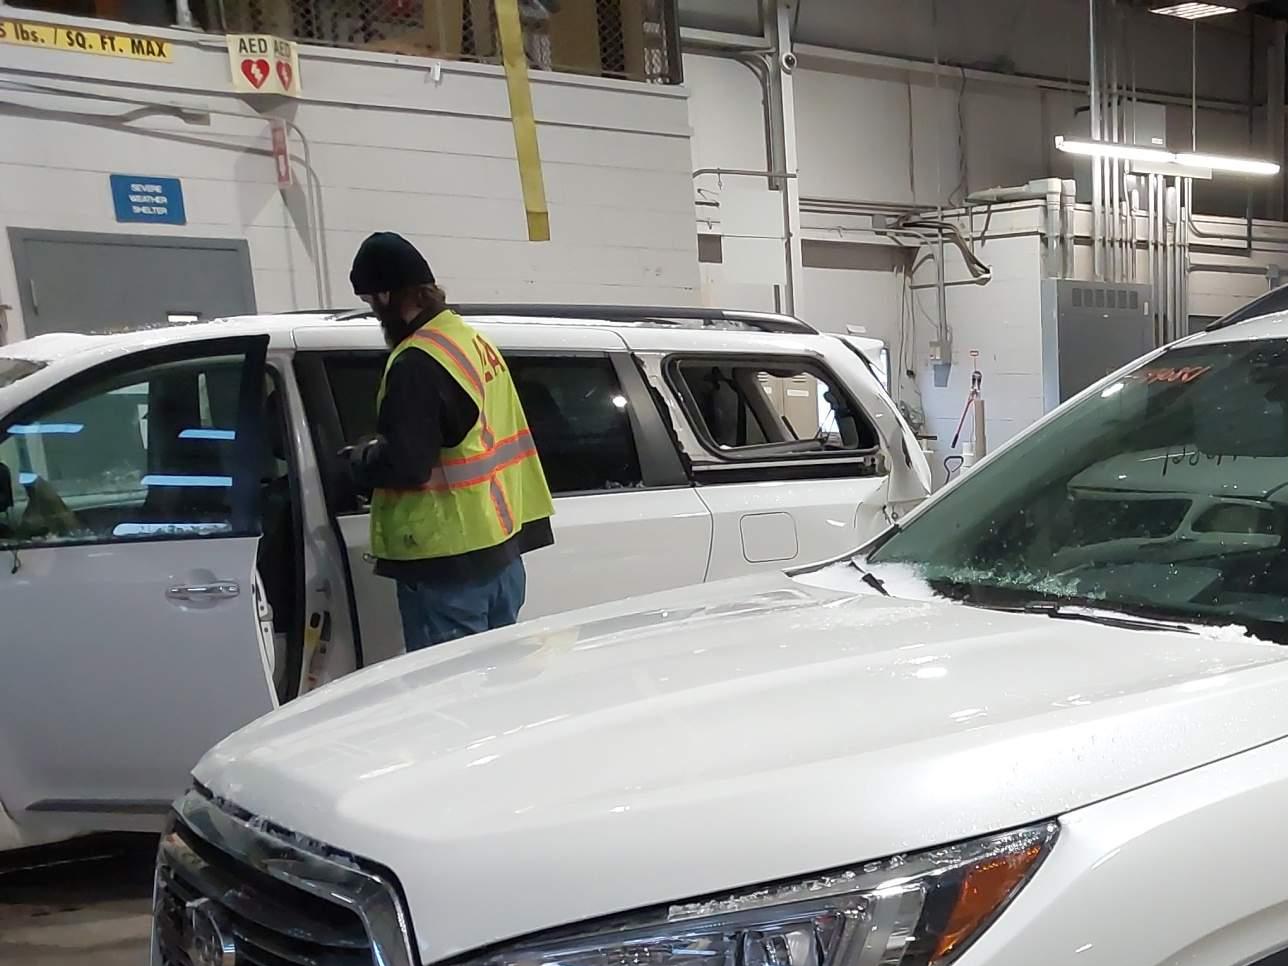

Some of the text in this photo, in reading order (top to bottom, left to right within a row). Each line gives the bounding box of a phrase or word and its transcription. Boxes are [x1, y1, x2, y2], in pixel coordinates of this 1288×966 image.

[13, 22, 45, 43] lbs.
[66, 30, 94, 50] SQ.
[100, 35, 124, 53] FT.
[130, 38, 167, 58] MAX
[239, 37, 268, 54] AED
[274, 39, 291, 58] AED
[130, 183, 163, 194] SEVERE
[128, 194, 168, 205] WEATHER
[131, 205, 168, 216] SHELTER
